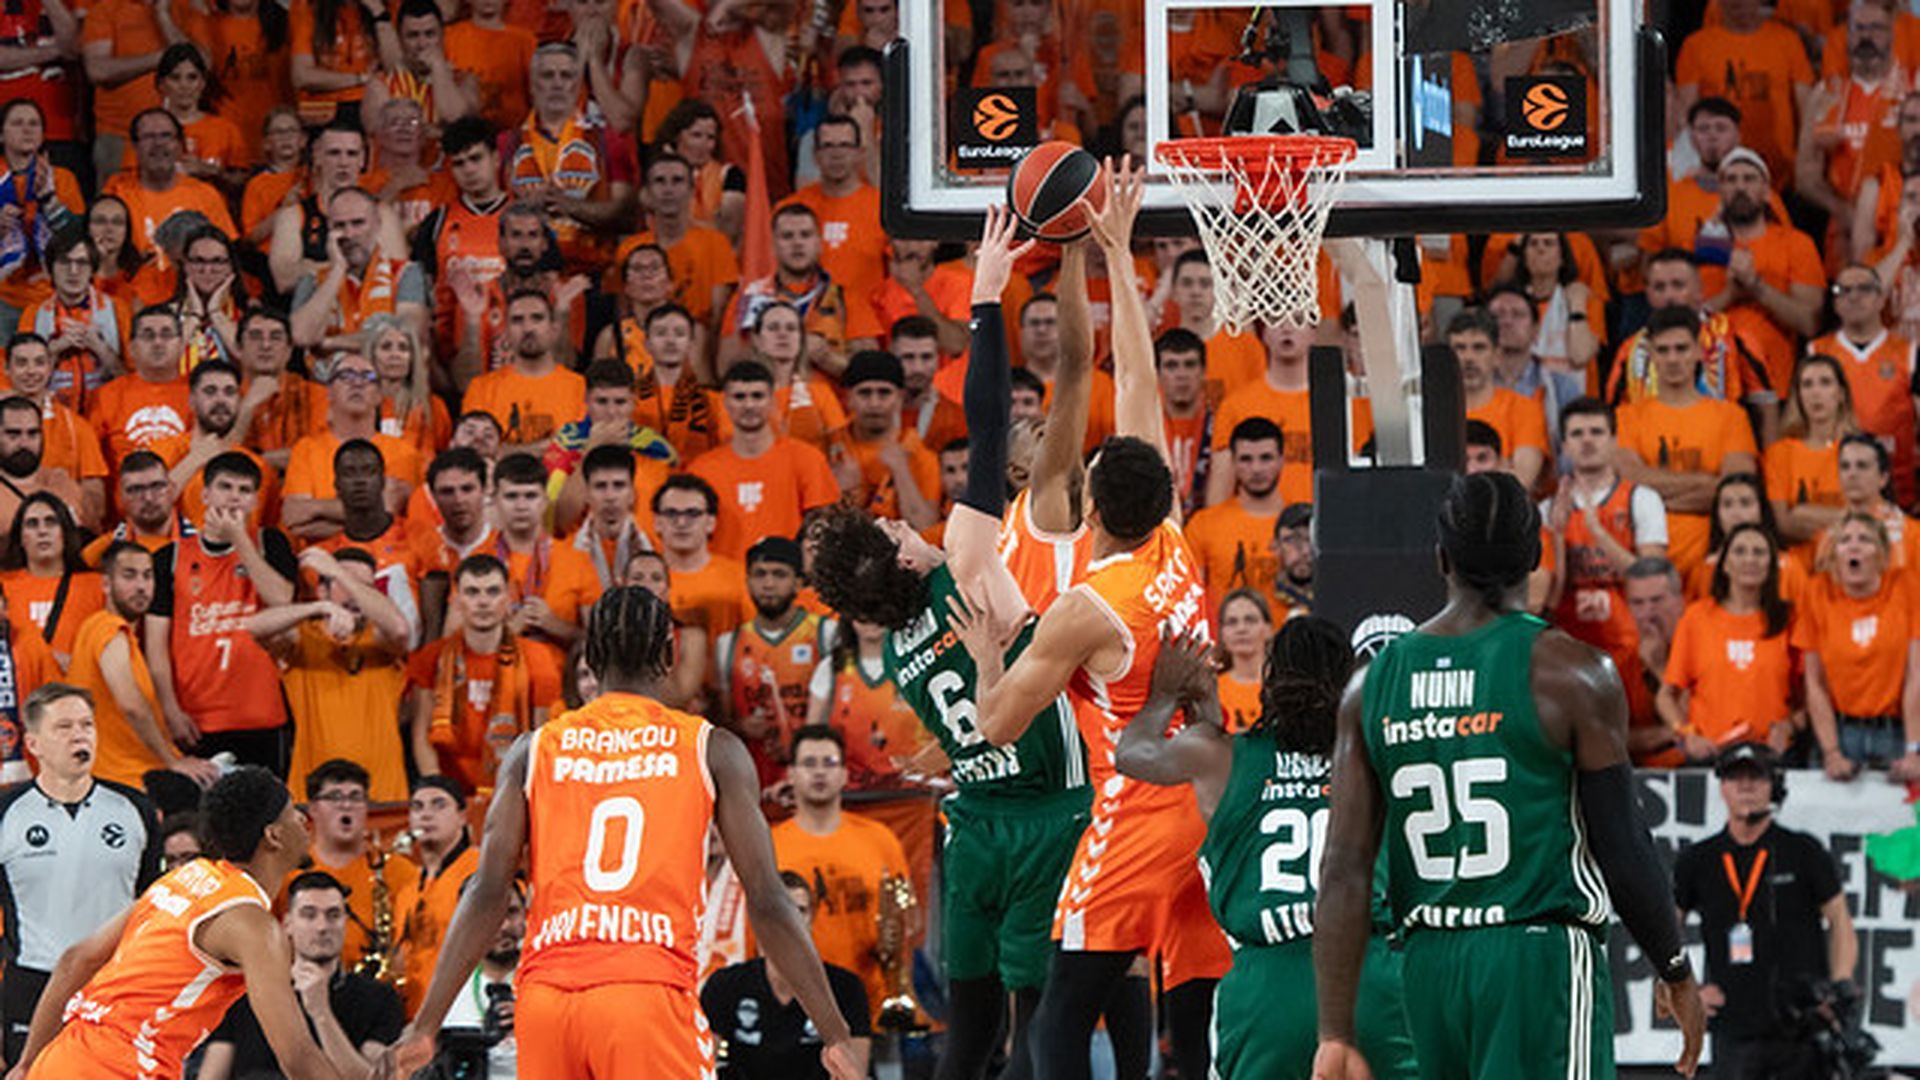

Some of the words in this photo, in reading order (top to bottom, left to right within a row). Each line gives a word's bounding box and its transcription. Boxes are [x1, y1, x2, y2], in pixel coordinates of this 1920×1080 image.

[957, 144, 1032, 159] EuroLeag
[1506, 134, 1585, 149] EuroLeague
[215, 638, 232, 672] 7
[1410, 669, 1475, 709] NUNN
[927, 669, 985, 747] 6
[561, 725, 677, 753] BRANCOU
[1382, 710, 1503, 746] instacar
[553, 752, 678, 784] PAMESA
[1391, 757, 1510, 880] 25
[583, 796, 645, 892] 0
